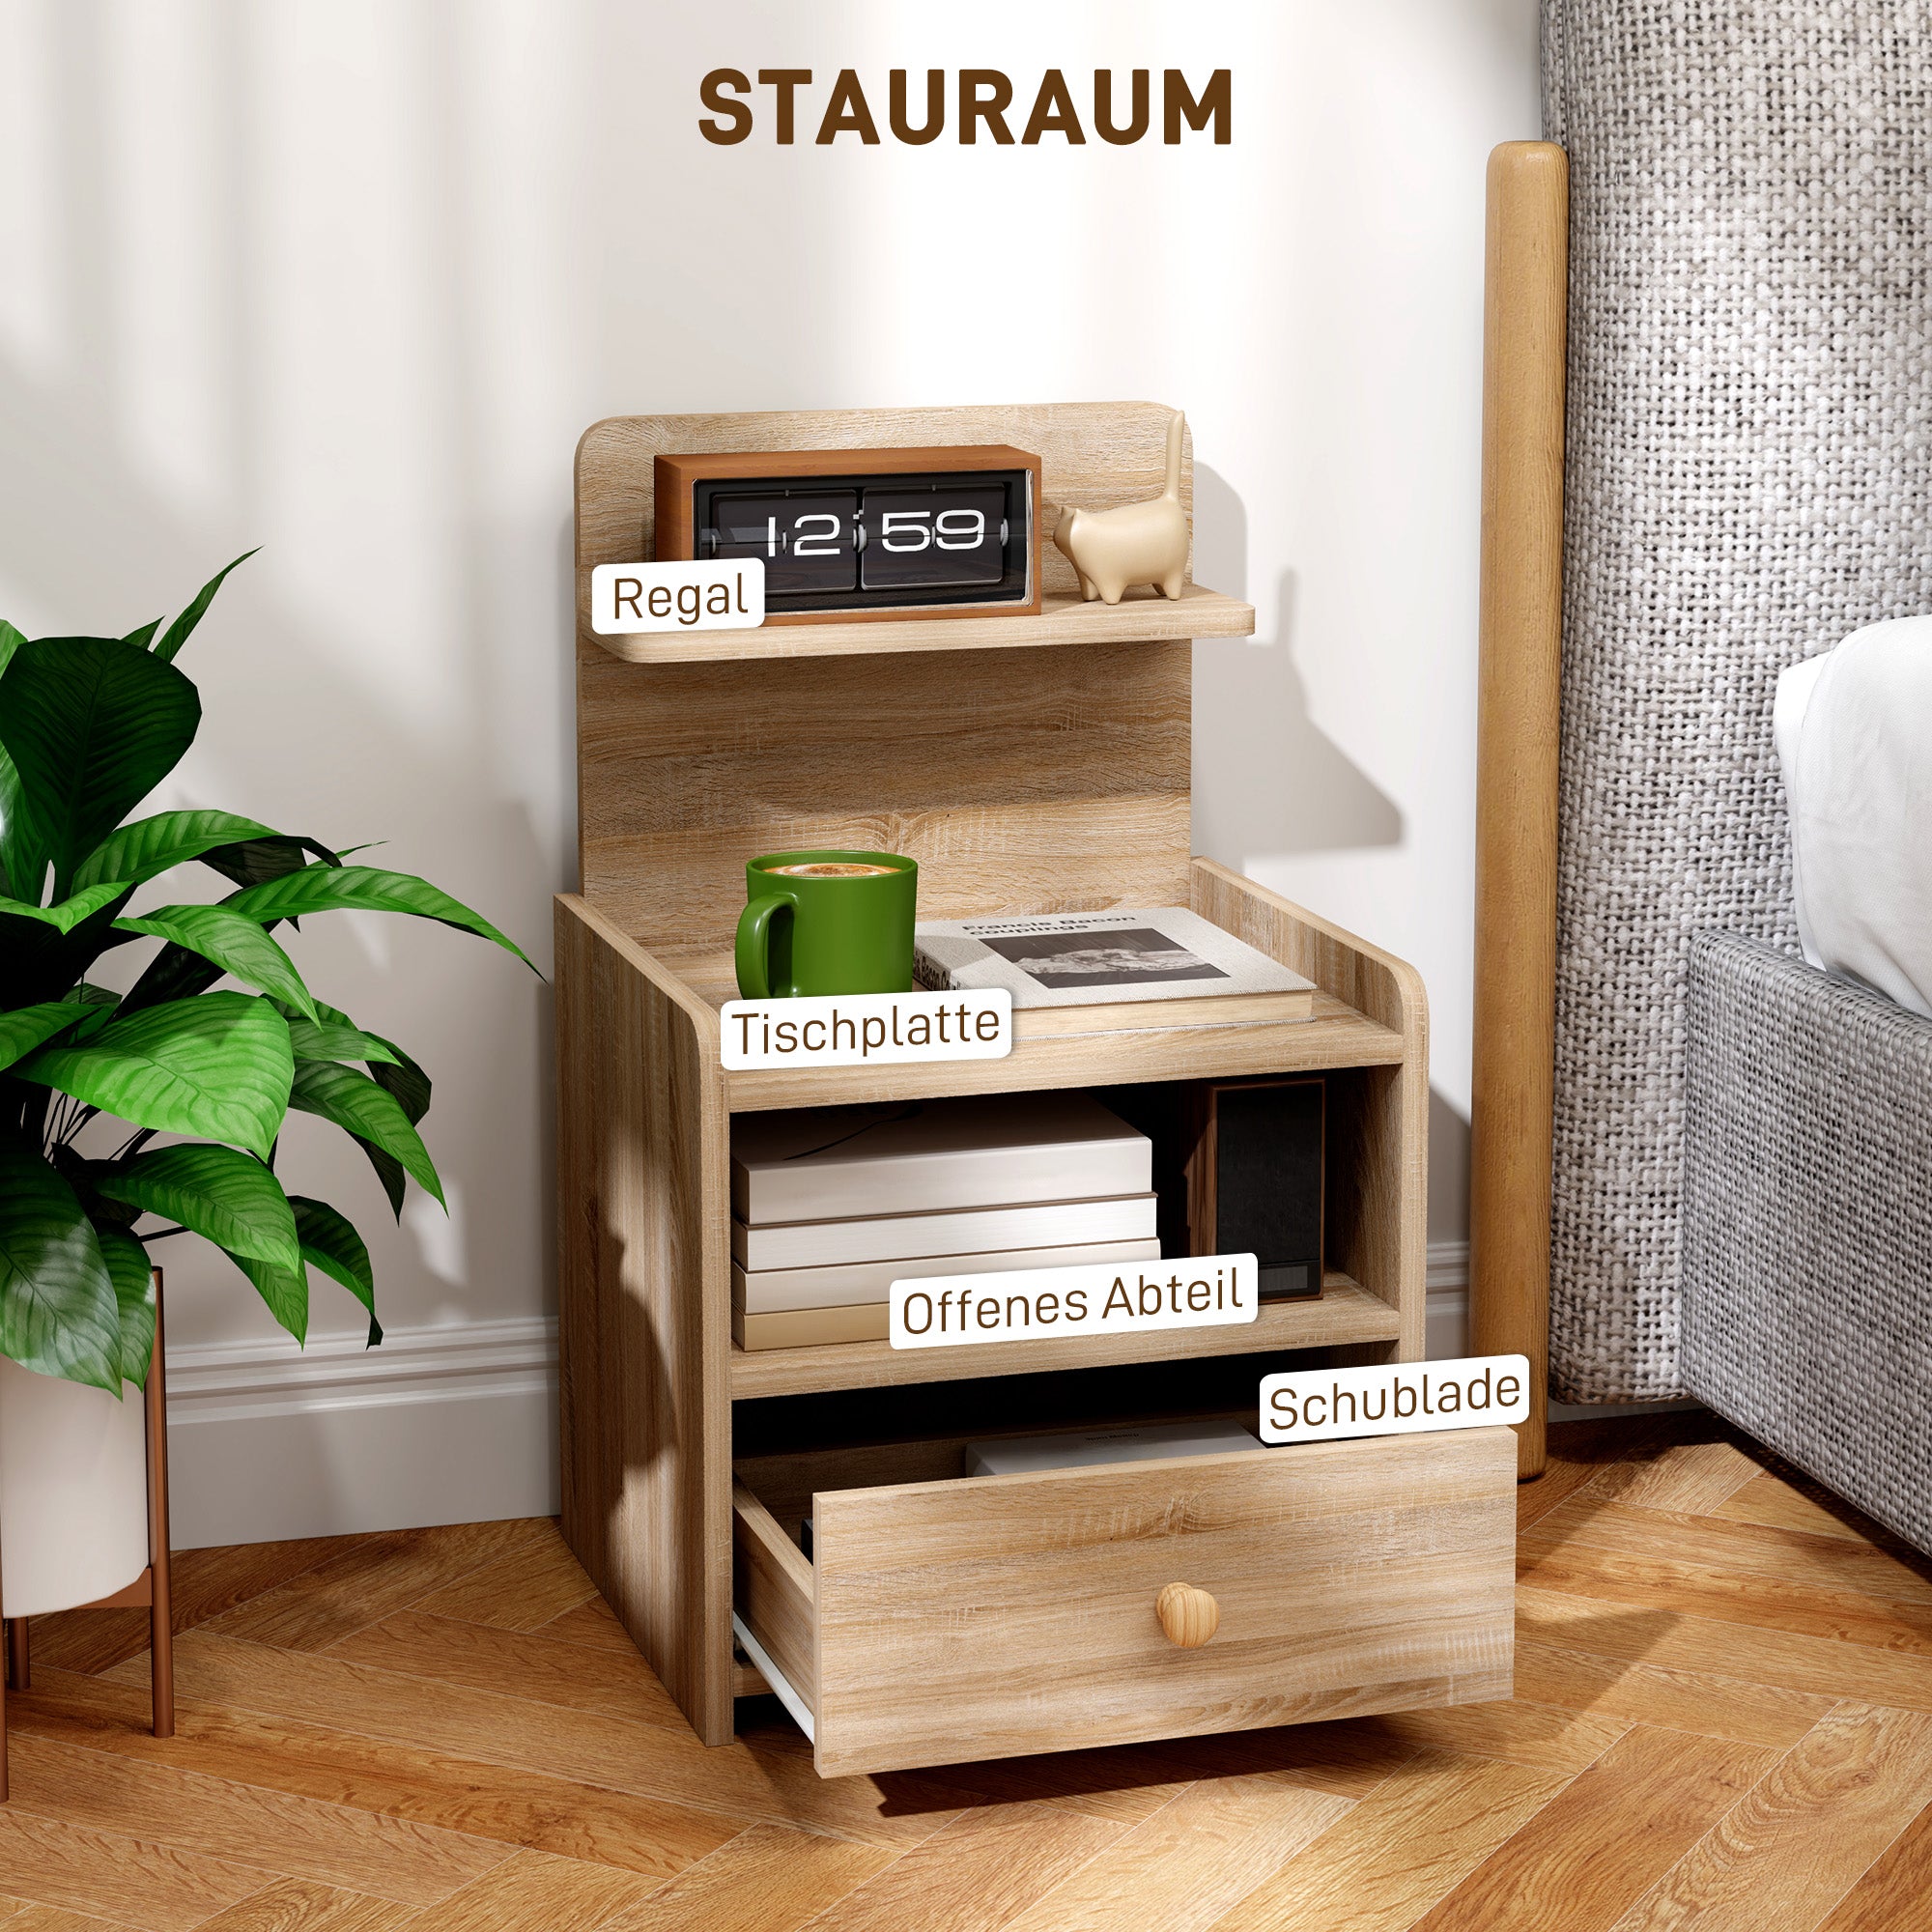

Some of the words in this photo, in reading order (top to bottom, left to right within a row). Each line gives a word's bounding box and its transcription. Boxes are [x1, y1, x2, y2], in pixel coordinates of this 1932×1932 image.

[767, 513, 840, 557] 12
[881, 508, 985, 553] 59
[962, 921, 1052, 931] Francis
[1059, 916, 1137, 925] Bacon
